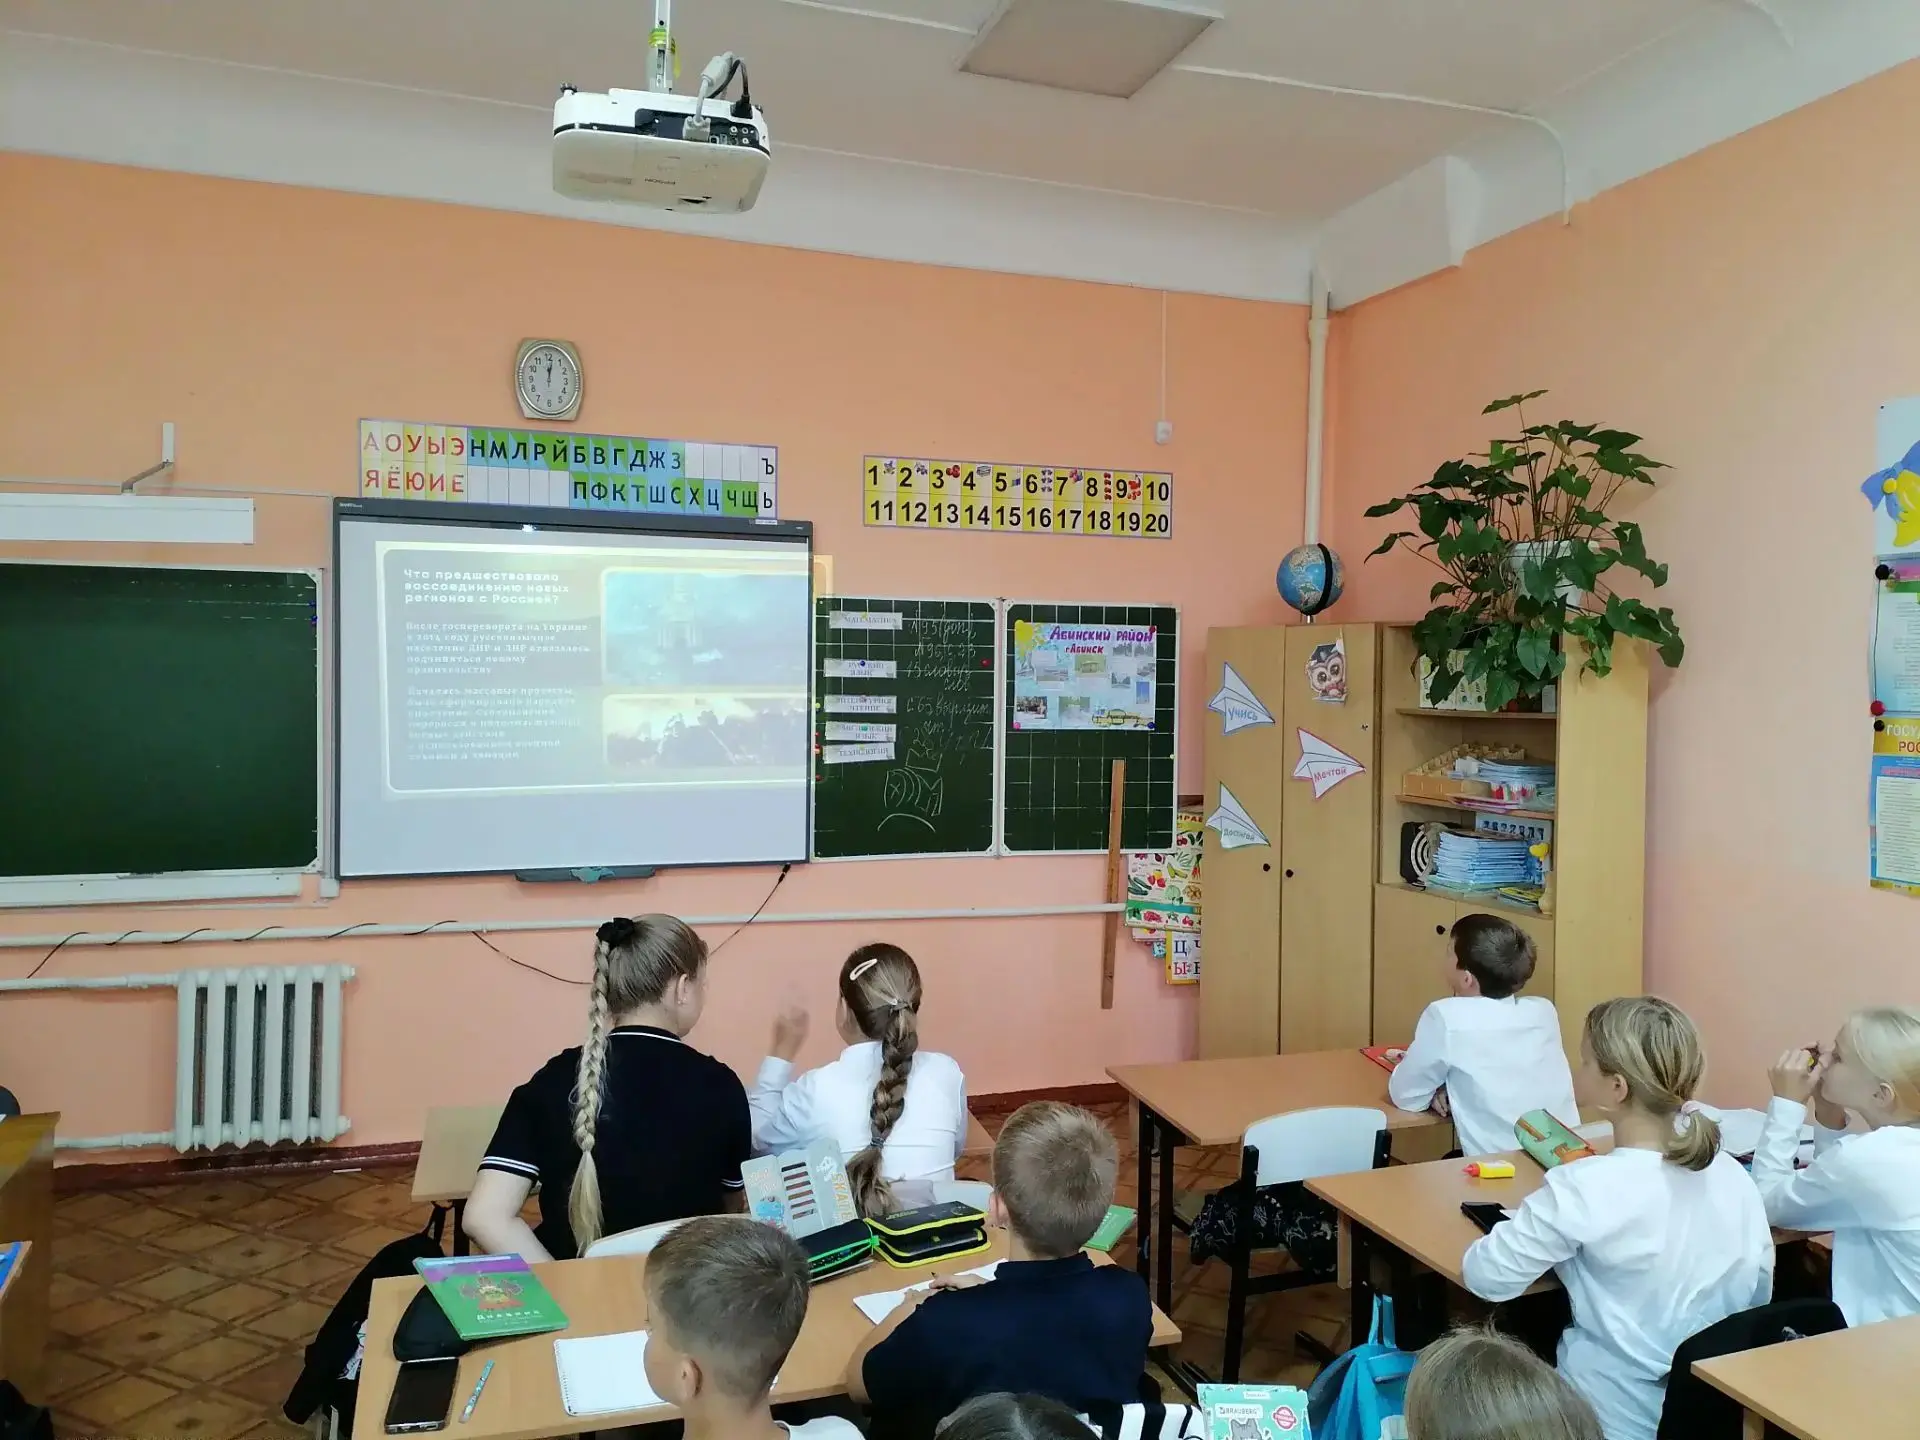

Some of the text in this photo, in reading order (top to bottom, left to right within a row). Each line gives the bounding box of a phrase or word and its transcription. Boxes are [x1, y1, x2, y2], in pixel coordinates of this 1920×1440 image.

[868, 465, 1169, 501] 1 2 3 4 5 6 7 8 9 10
[871, 500, 1168, 533] 11 12 13 14 15 16 17 18 19 20
[404, 569, 559, 582] Что предшествовало
[527, 584, 569, 594] новых
[405, 594, 474, 605] регионов
[1313, 767, 1347, 783] Мечтай
[1174, 940, 1187, 956] Ц
[1174, 962, 1188, 975] Ы
